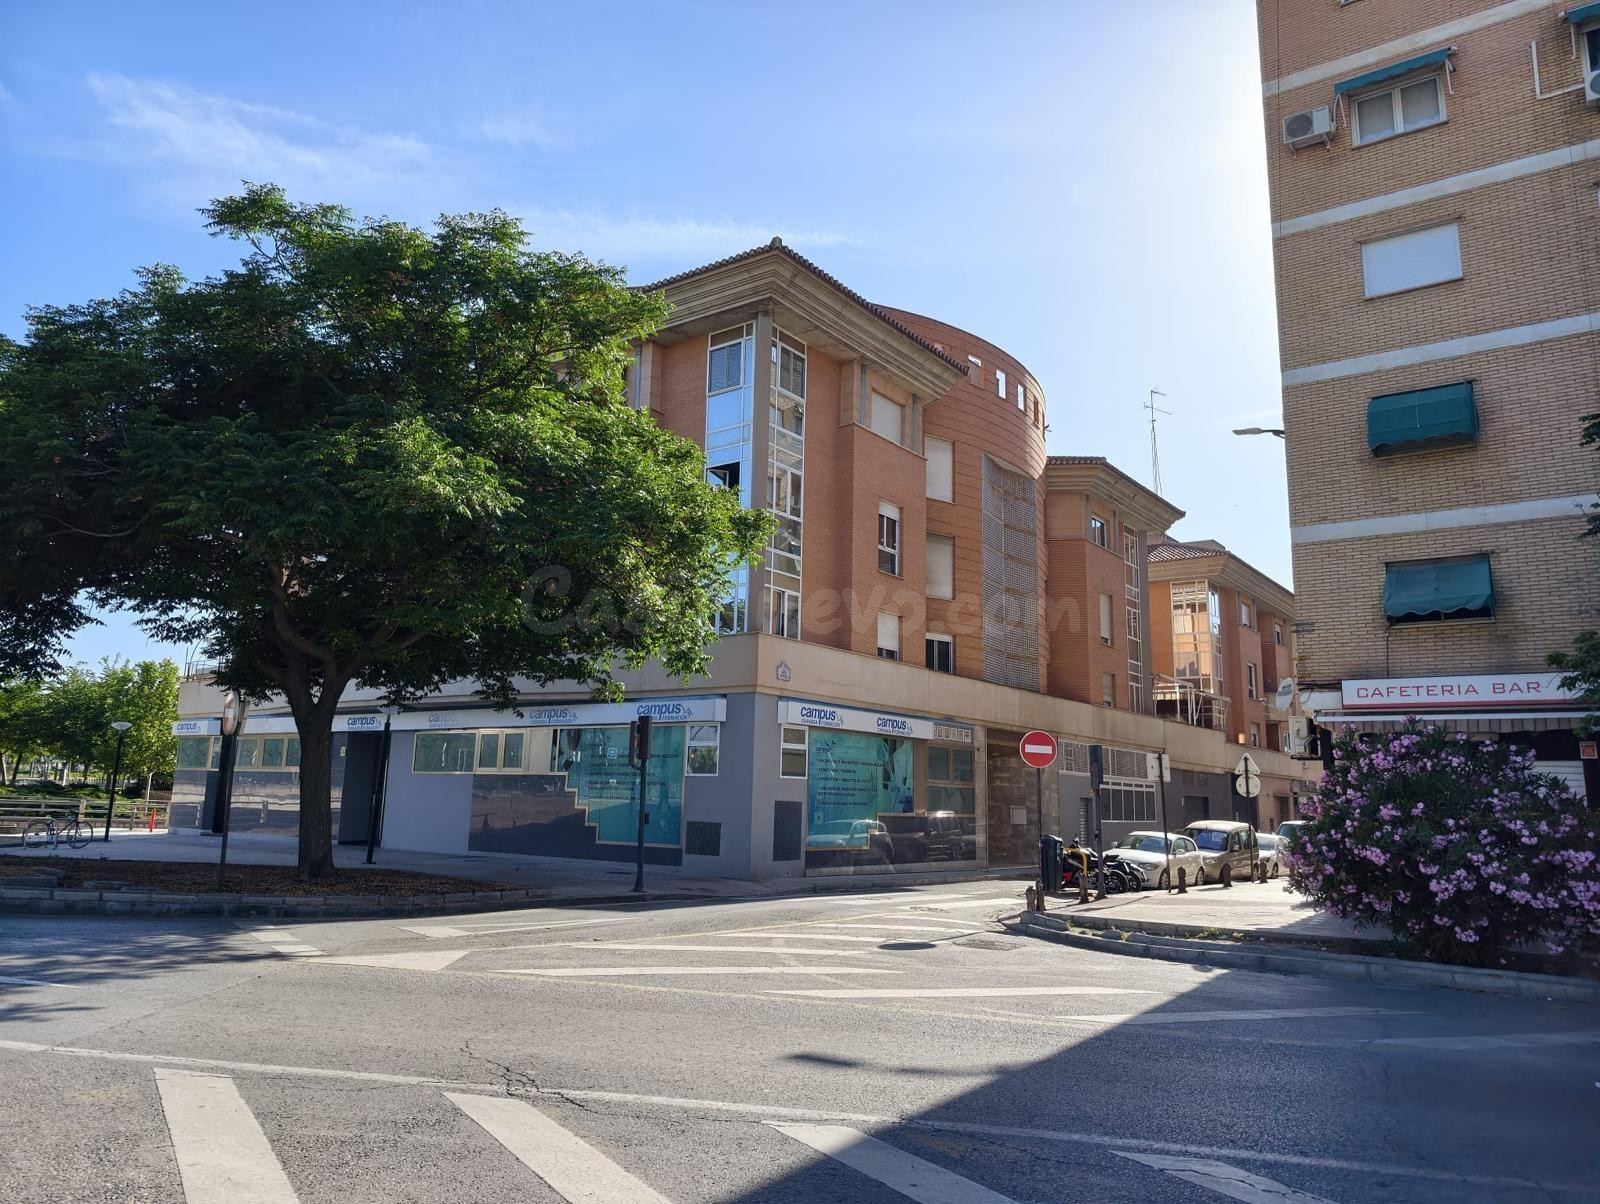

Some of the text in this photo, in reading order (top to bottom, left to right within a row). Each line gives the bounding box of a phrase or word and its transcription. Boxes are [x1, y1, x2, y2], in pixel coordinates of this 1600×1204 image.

[1356, 681, 1542, 699] CAFETERIA BAR
[529, 707, 568, 724] campus
[636, 703, 682, 721] campus
[800, 706, 836, 725] campus
[347, 716, 376, 731] campus
[876, 717, 907, 735] campus
